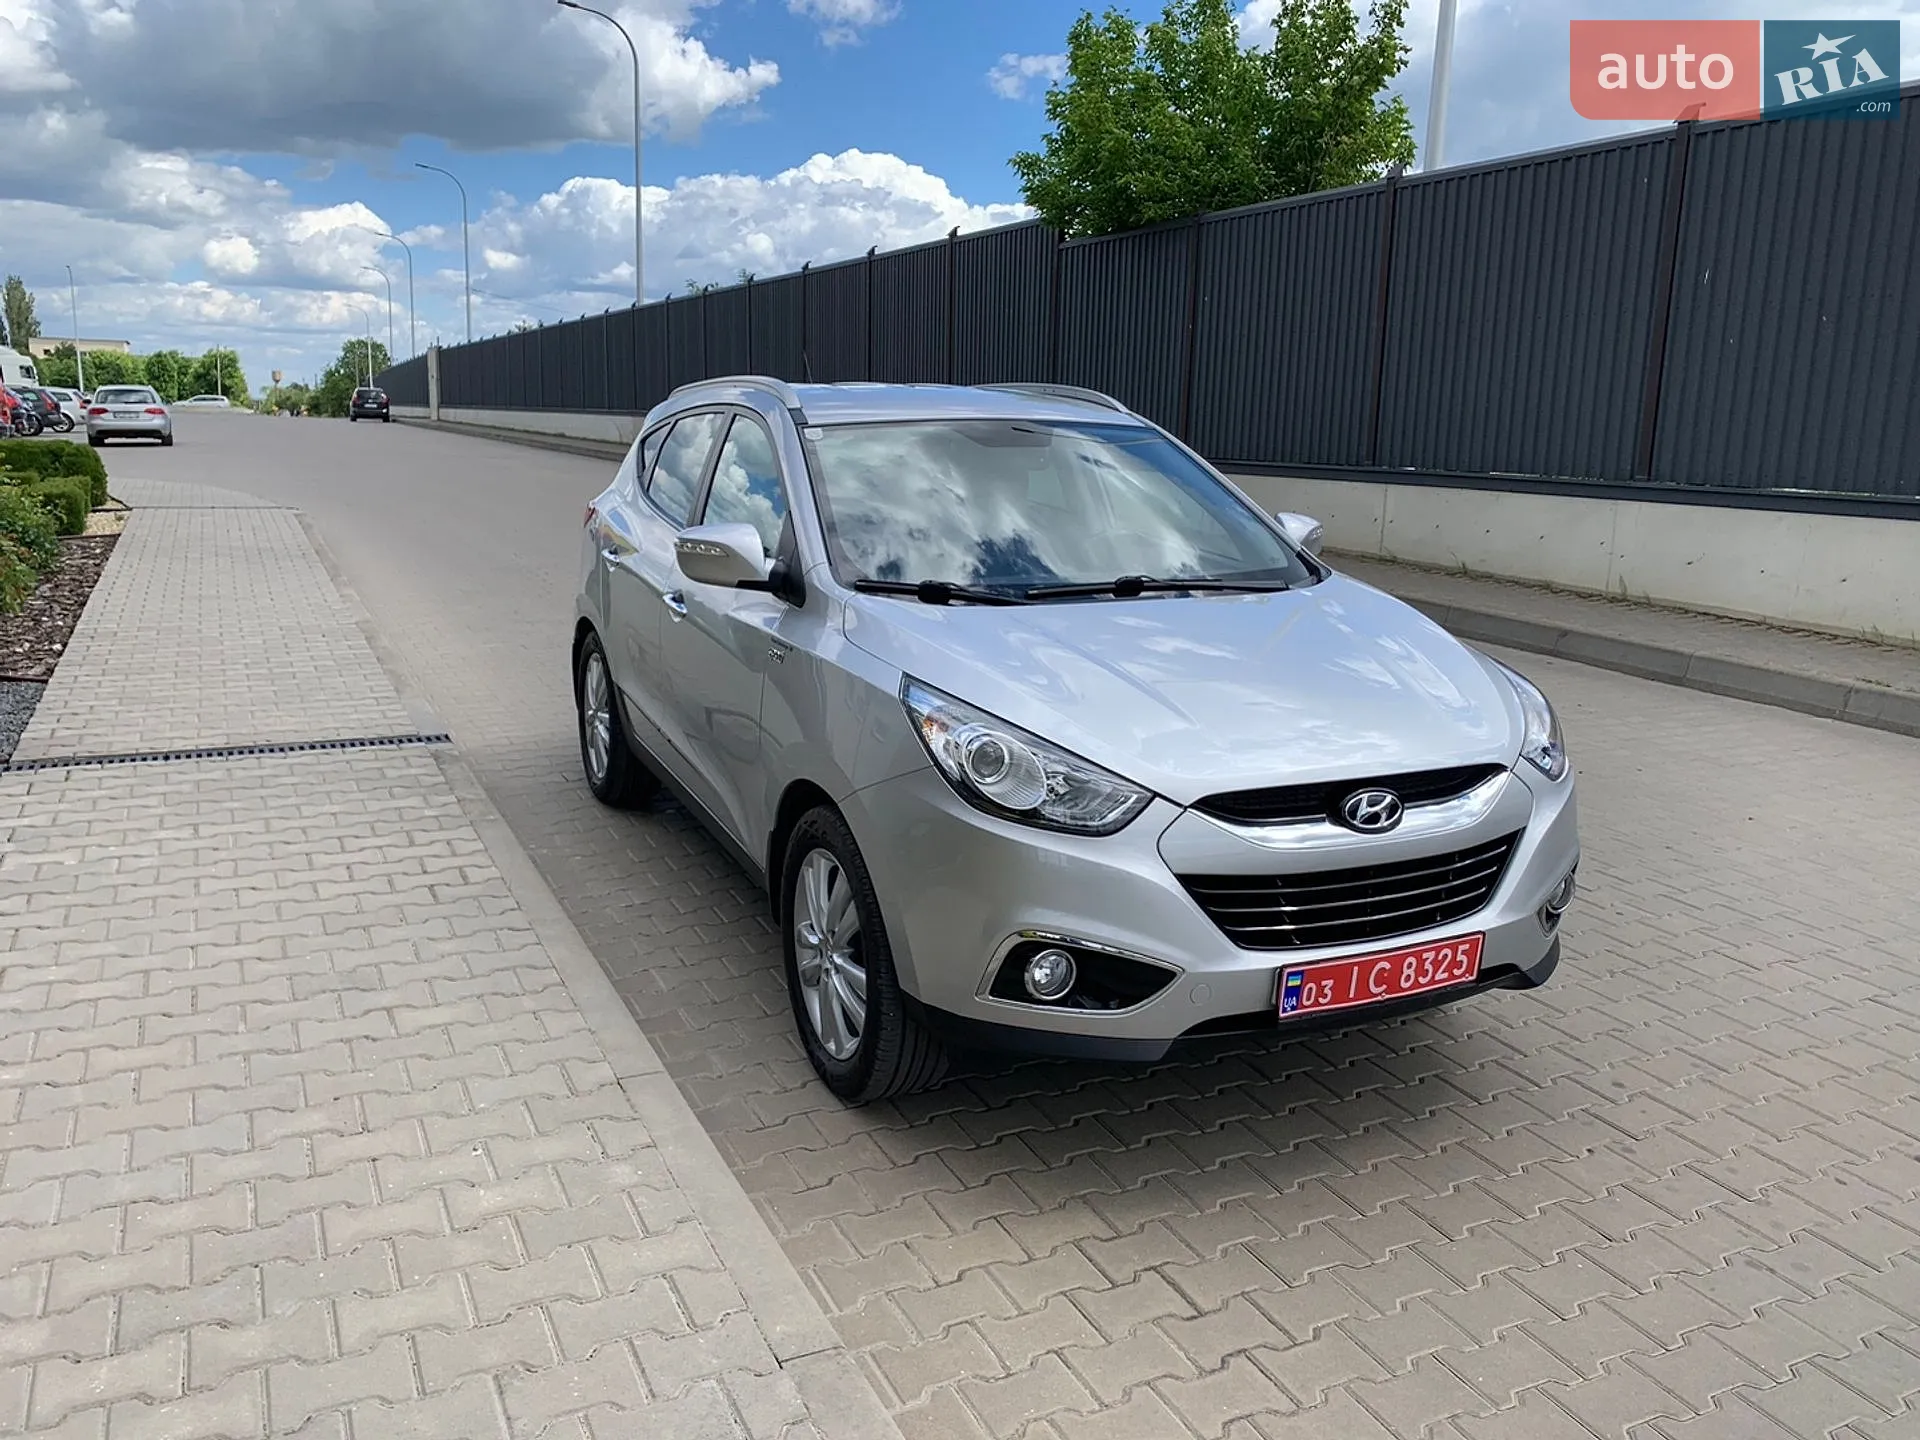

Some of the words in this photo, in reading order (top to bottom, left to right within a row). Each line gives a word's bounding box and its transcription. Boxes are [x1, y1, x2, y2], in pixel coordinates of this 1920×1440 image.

[1302, 979, 1335, 1007] 03
[1399, 944, 1470, 989] 8325
[1284, 996, 1297, 1008] UA
